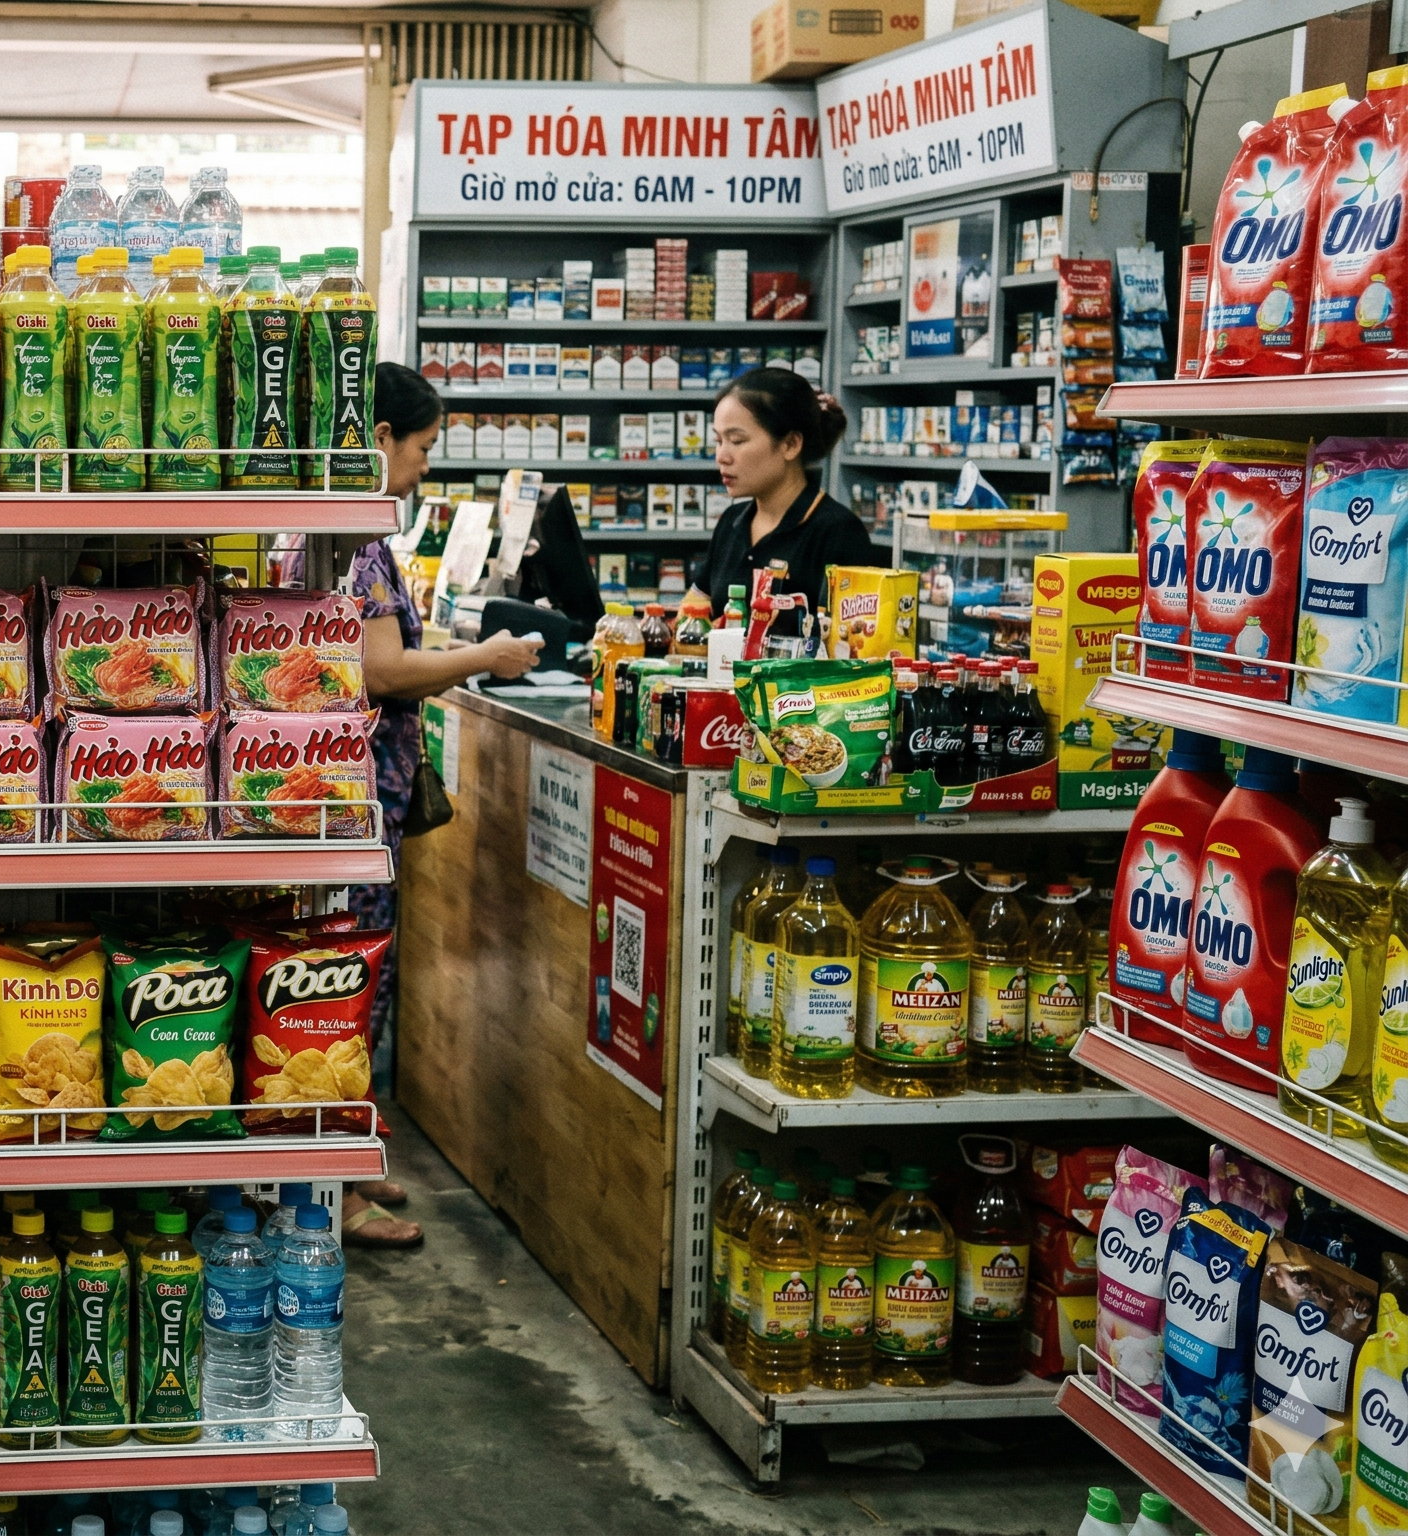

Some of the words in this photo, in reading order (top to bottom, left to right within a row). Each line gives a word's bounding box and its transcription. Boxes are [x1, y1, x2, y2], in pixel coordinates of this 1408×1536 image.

[826, 97, 861, 158] TẠP
[866, 79, 910, 140] HÓA
[913, 64, 973, 128] MINH
[980, 41, 1037, 109] TÂM
[438, 114, 513, 164] TẠP
[527, 106, 607, 157] HÓA
[622, 116, 729, 159] MINH
[744, 107, 821, 159] TÂM
[842, 163, 865, 195] Giờ
[869, 152, 890, 187] mở
[927, 138, 962, 173] 6AM
[977, 122, 1025, 164] 10PM
[460, 172, 506, 201] Giờ
[515, 171, 559, 201] mở
[567, 171, 623, 202] cửa:
[634, 176, 695, 203] 6AM
[725, 176, 801, 204] 10PM
[1222, 208, 1305, 264] OMO
[1323, 193, 1403, 256] OMO
[1148, 542, 1187, 588] OM
[1309, 525, 1382, 565] Comfort
[1087, 586, 1141, 600] Magg
[1195, 546, 1272, 596] OMO
[58, 604, 124, 650] Hảo
[129, 595, 193, 639] Hảo
[229, 612, 294, 655] Hảo
[298, 605, 361, 647] Hảo
[71, 737, 138, 782] Hảo
[143, 730, 205, 774] Hảo
[233, 729, 299, 772] Hảo
[304, 723, 367, 766] Hảo
[1195, 909, 1253, 967] OMO
[3, 979, 60, 1000] Kinh
[127, 972, 227, 1022] Poca
[266, 960, 363, 1011] Poca
[814, 967, 849, 982] Simply
[1288, 956, 1344, 993] Sunlight
[893, 993, 960, 1007] MELIZAN
[1100, 1226, 1163, 1276] Comfor
[1168, 1270, 1230, 1324] Comfort
[1257, 1323, 1339, 1384] Comfort
